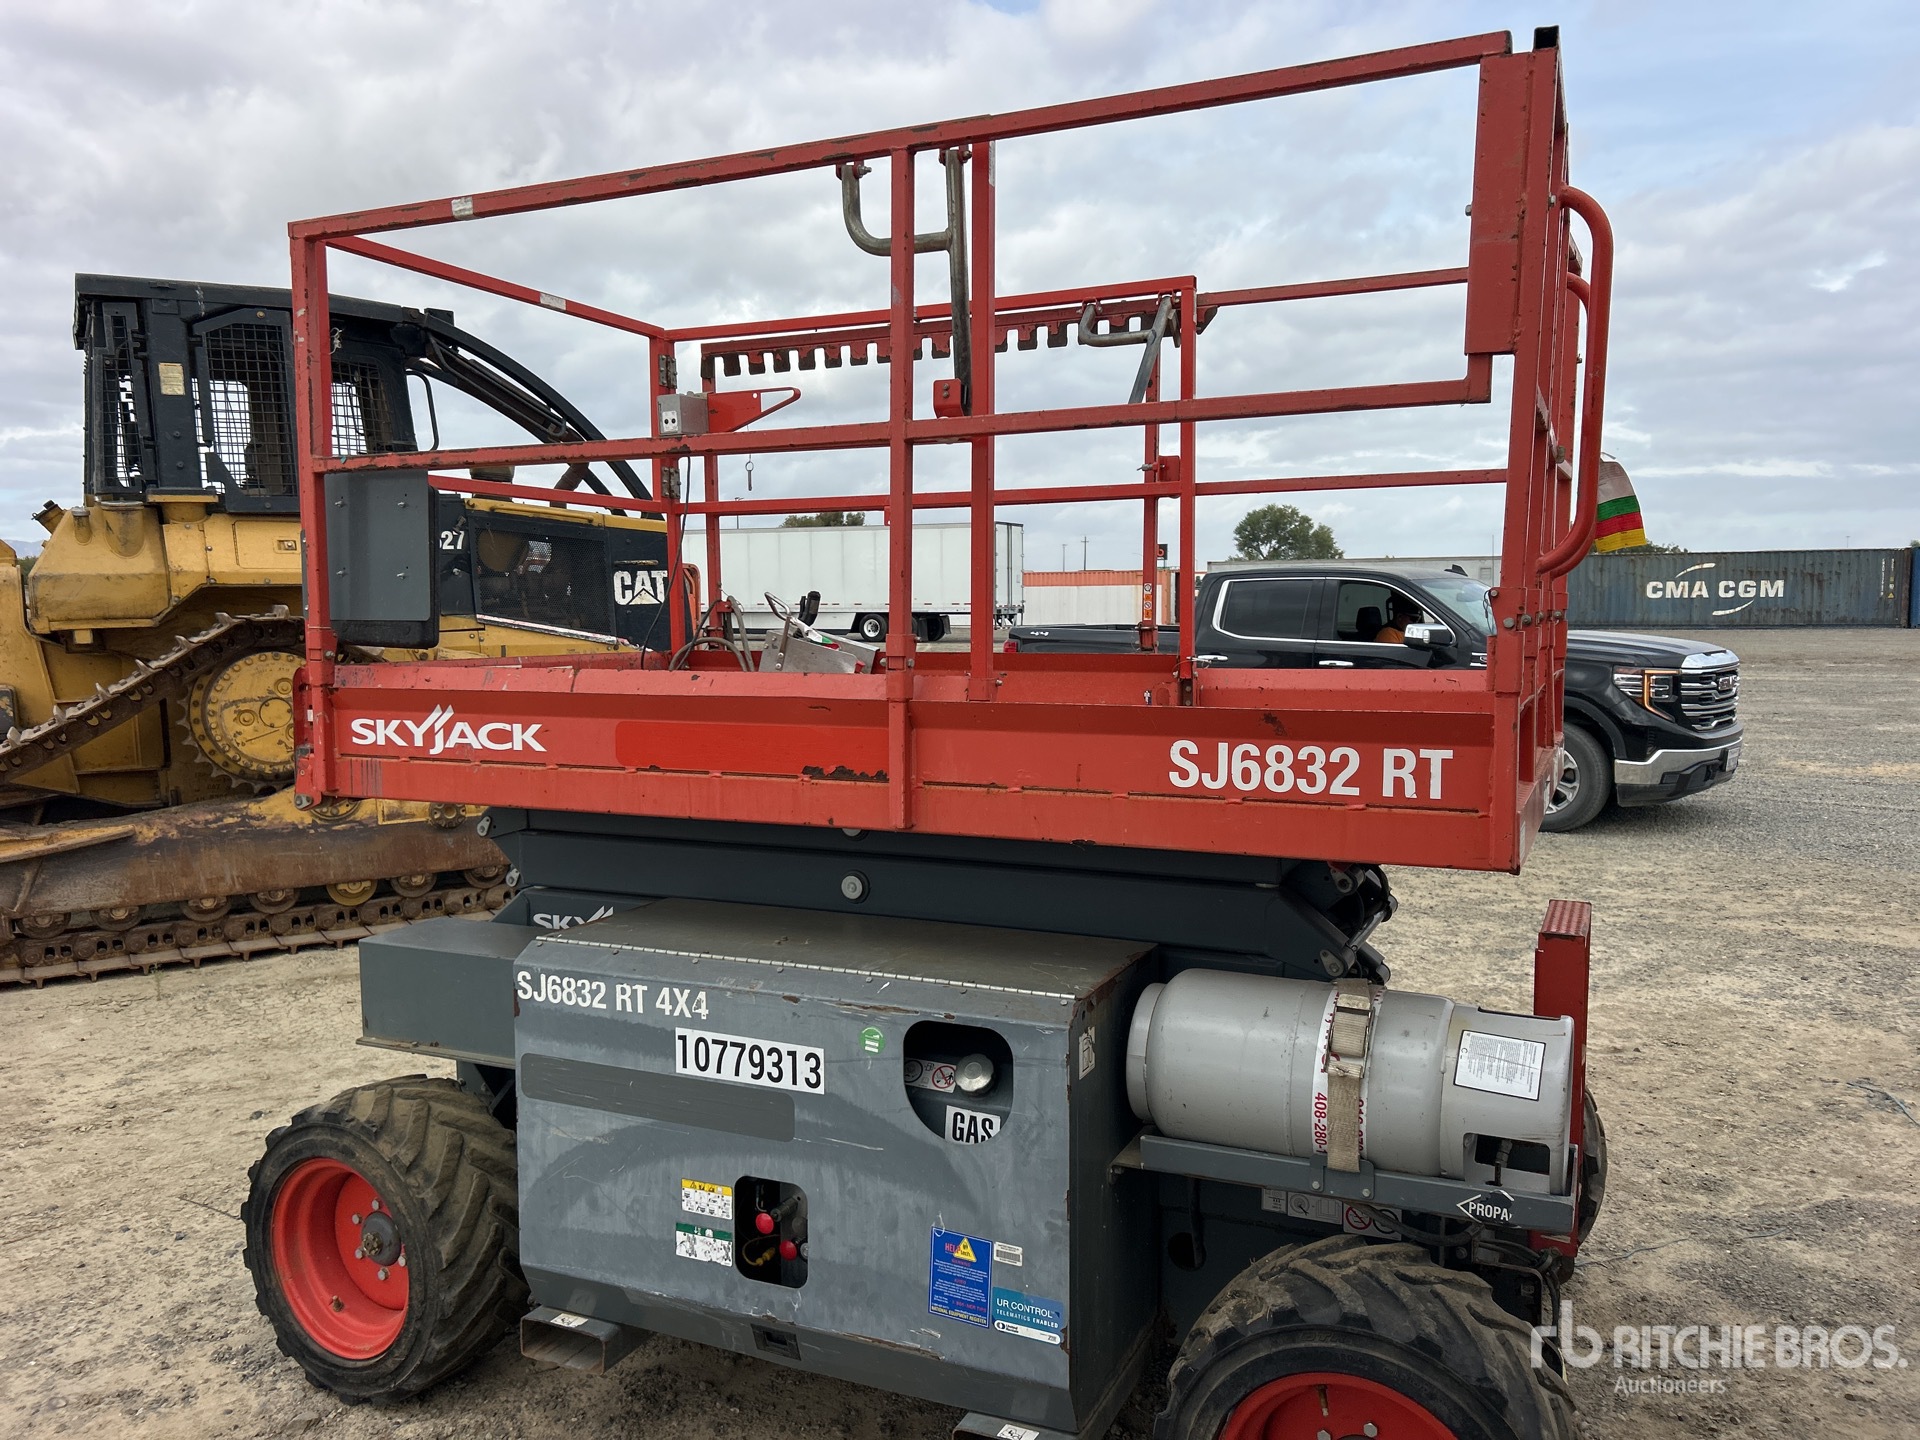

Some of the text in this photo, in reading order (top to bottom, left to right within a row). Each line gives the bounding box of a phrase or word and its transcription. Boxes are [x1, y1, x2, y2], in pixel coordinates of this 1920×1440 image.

[439, 530, 465, 550] 27
[613, 570, 668, 606] CAT
[1646, 580, 1785, 599] CMA CGM
[351, 704, 547, 755] SKYJACK
[1168, 740, 1454, 800] SJ6832 RT
[533, 906, 614, 930] SKY
[517, 970, 709, 1020] SJ6832 RT 4X4
[677, 1034, 822, 1089] 10779313
[952, 1111, 994, 1144] GAS
[996, 1298, 1009, 1308] UR
[996, 1308, 1031, 1322] TELEMATICS
[1032, 1317, 1059, 1329] ENABLED
